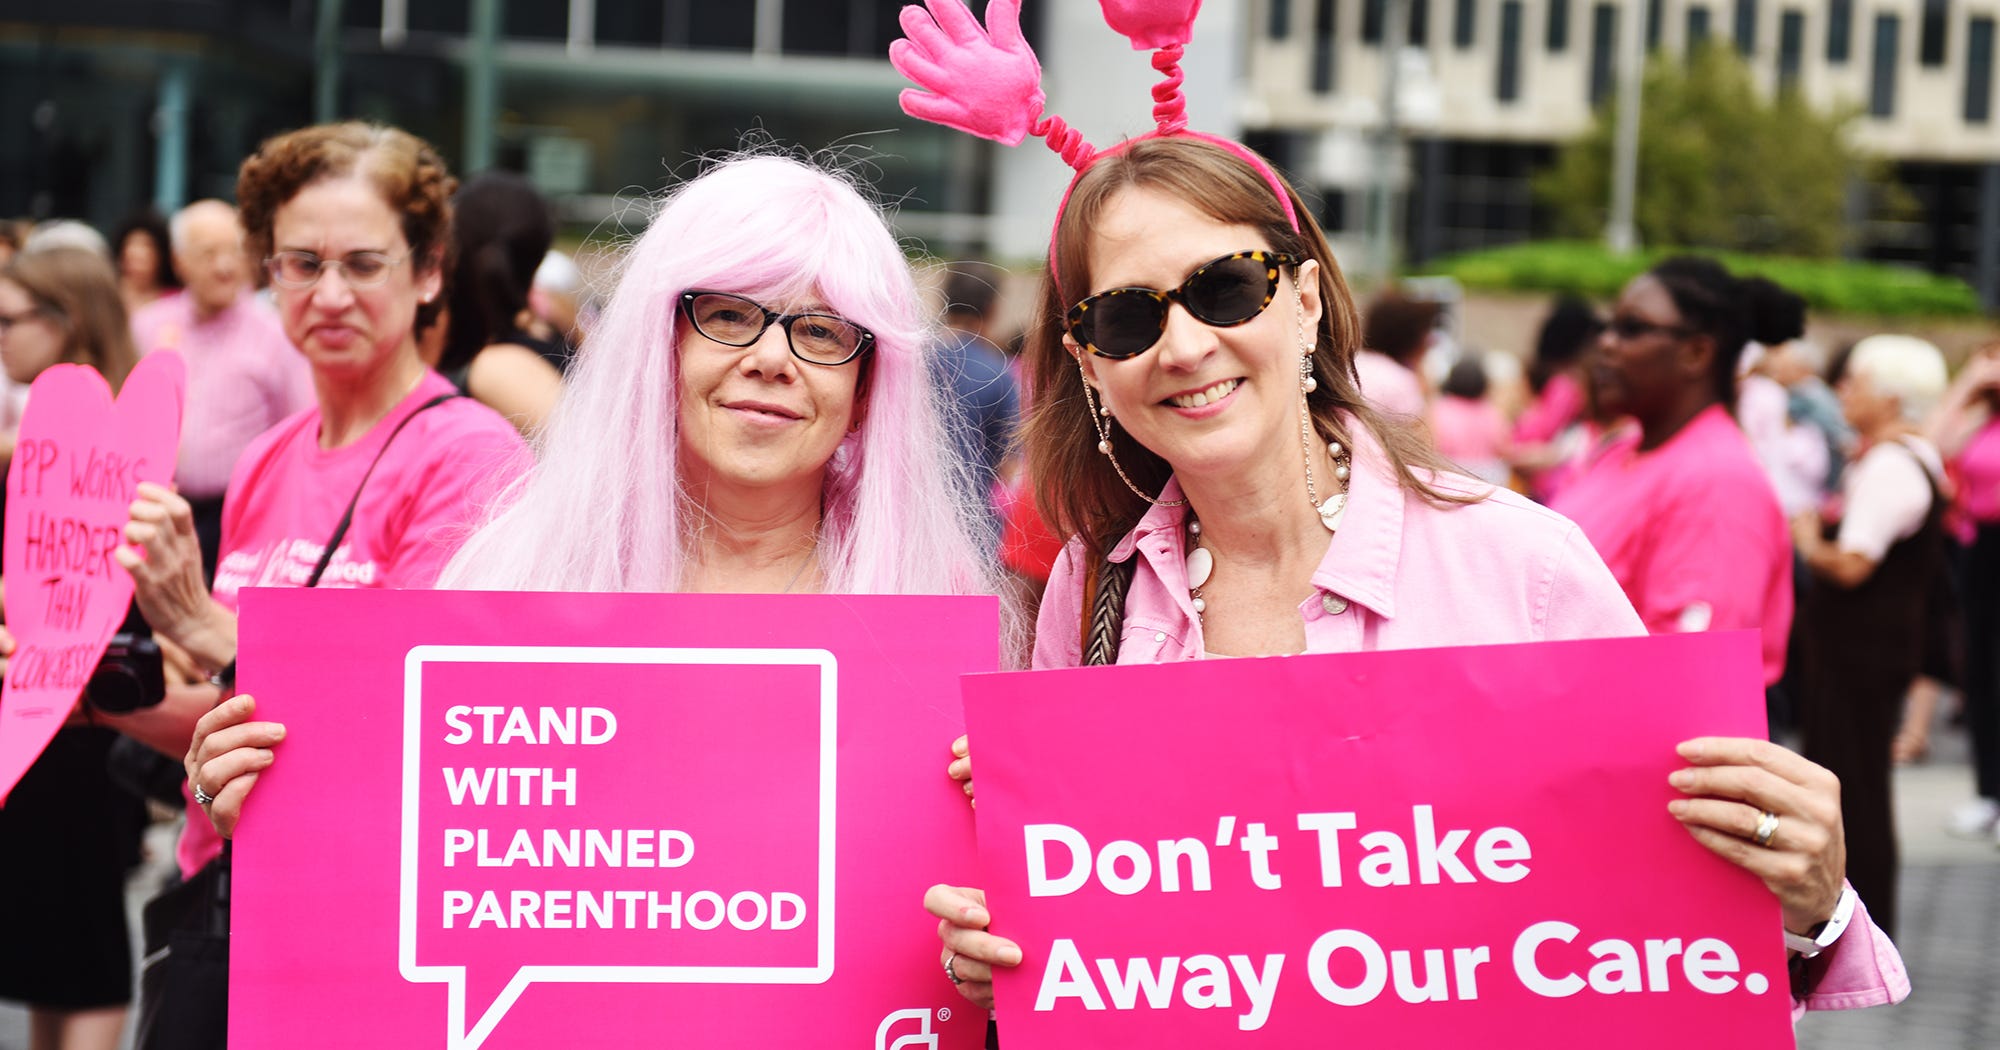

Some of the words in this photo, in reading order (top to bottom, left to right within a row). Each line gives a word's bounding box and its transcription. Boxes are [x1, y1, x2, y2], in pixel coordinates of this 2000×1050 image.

[18, 437, 59, 498] PP
[69, 444, 151, 504] WORKS
[24, 508, 120, 582] HARDER
[40, 574, 92, 632] THAN
[443, 705, 618, 745] STAND
[442, 767, 577, 806] WITH
[443, 828, 695, 868] PLANNED
[1023, 815, 1282, 897] Don't
[1297, 804, 1532, 888] Take
[442, 890, 807, 931] PARENTHOOD
[1034, 938, 1286, 1031] Away
[1307, 928, 1490, 1007] Our
[1512, 920, 1769, 998] Care.
